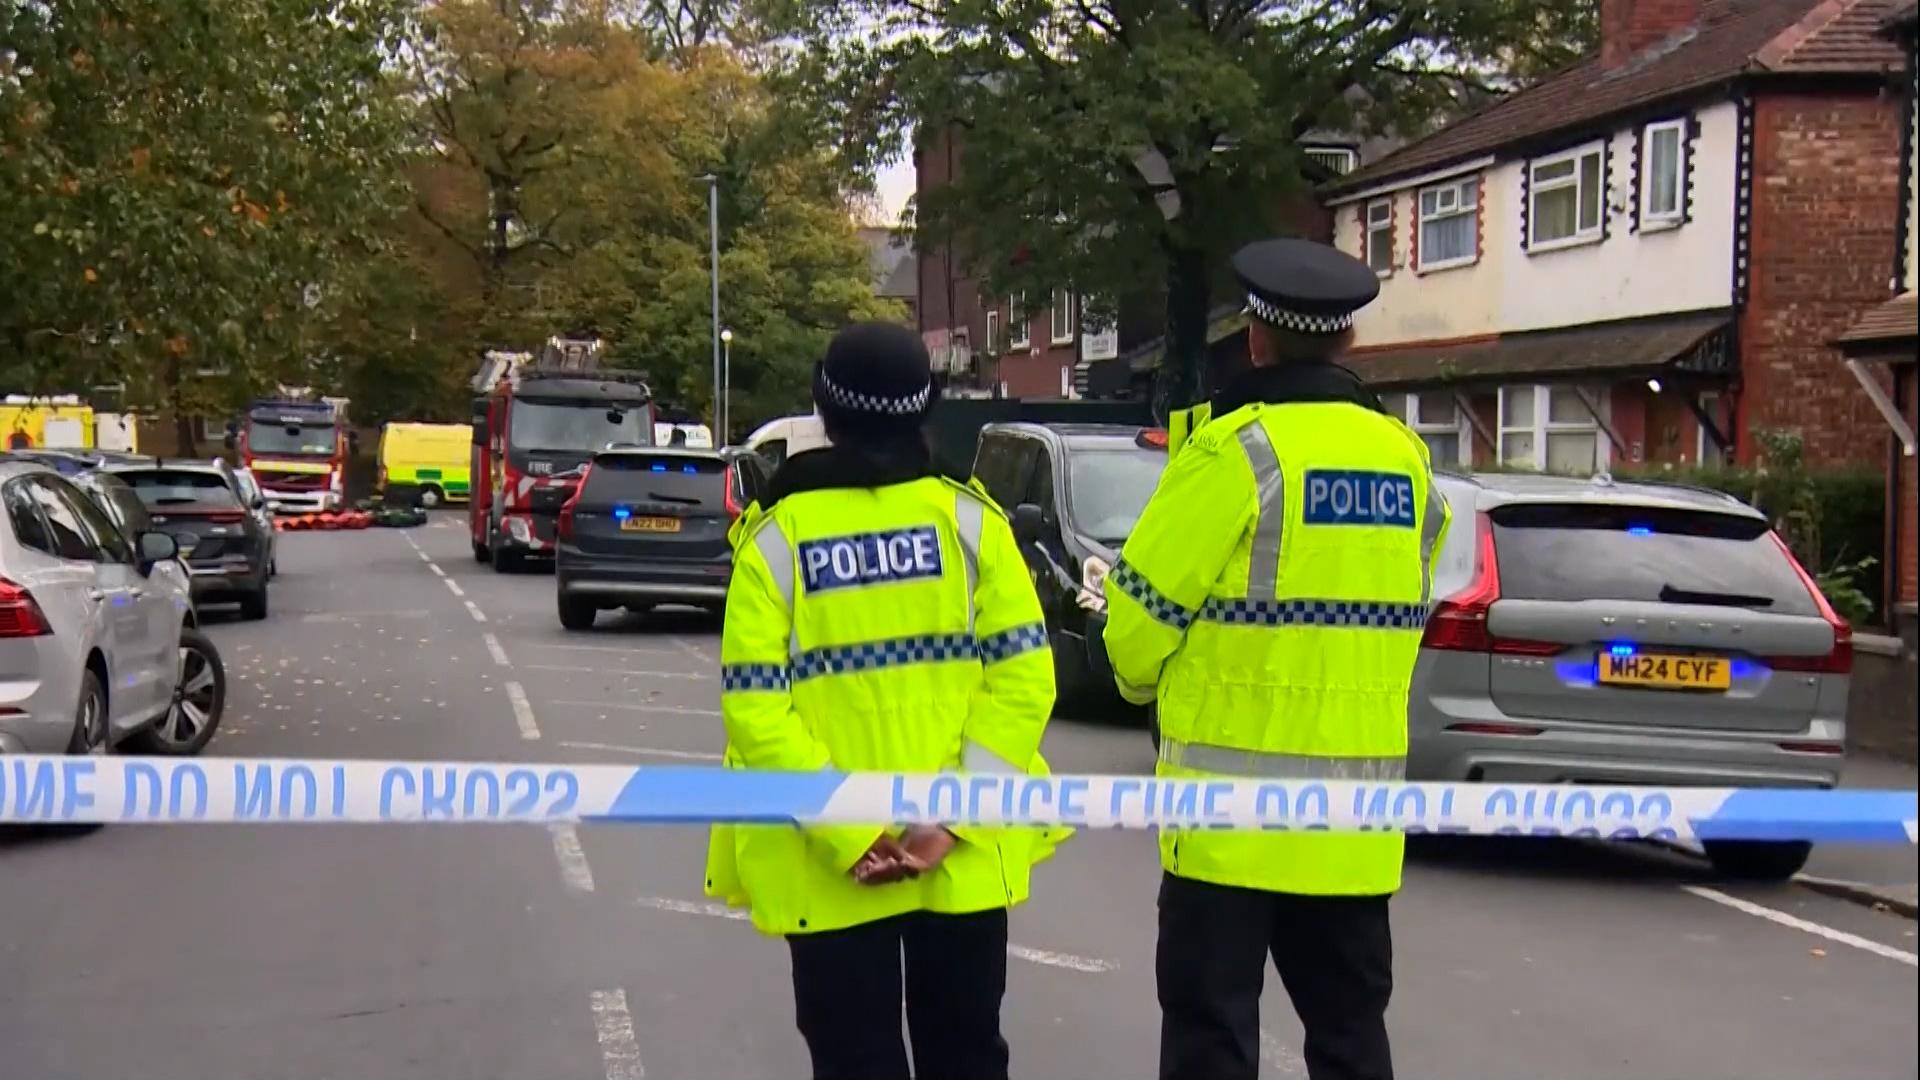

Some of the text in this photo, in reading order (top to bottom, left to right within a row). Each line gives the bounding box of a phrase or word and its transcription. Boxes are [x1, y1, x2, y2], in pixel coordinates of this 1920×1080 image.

[528, 461, 553, 474] FIRE
[1310, 477, 1411, 518] POLICE
[805, 532, 937, 586] POLICE
[1609, 653, 1720, 683] MH24 CYF
